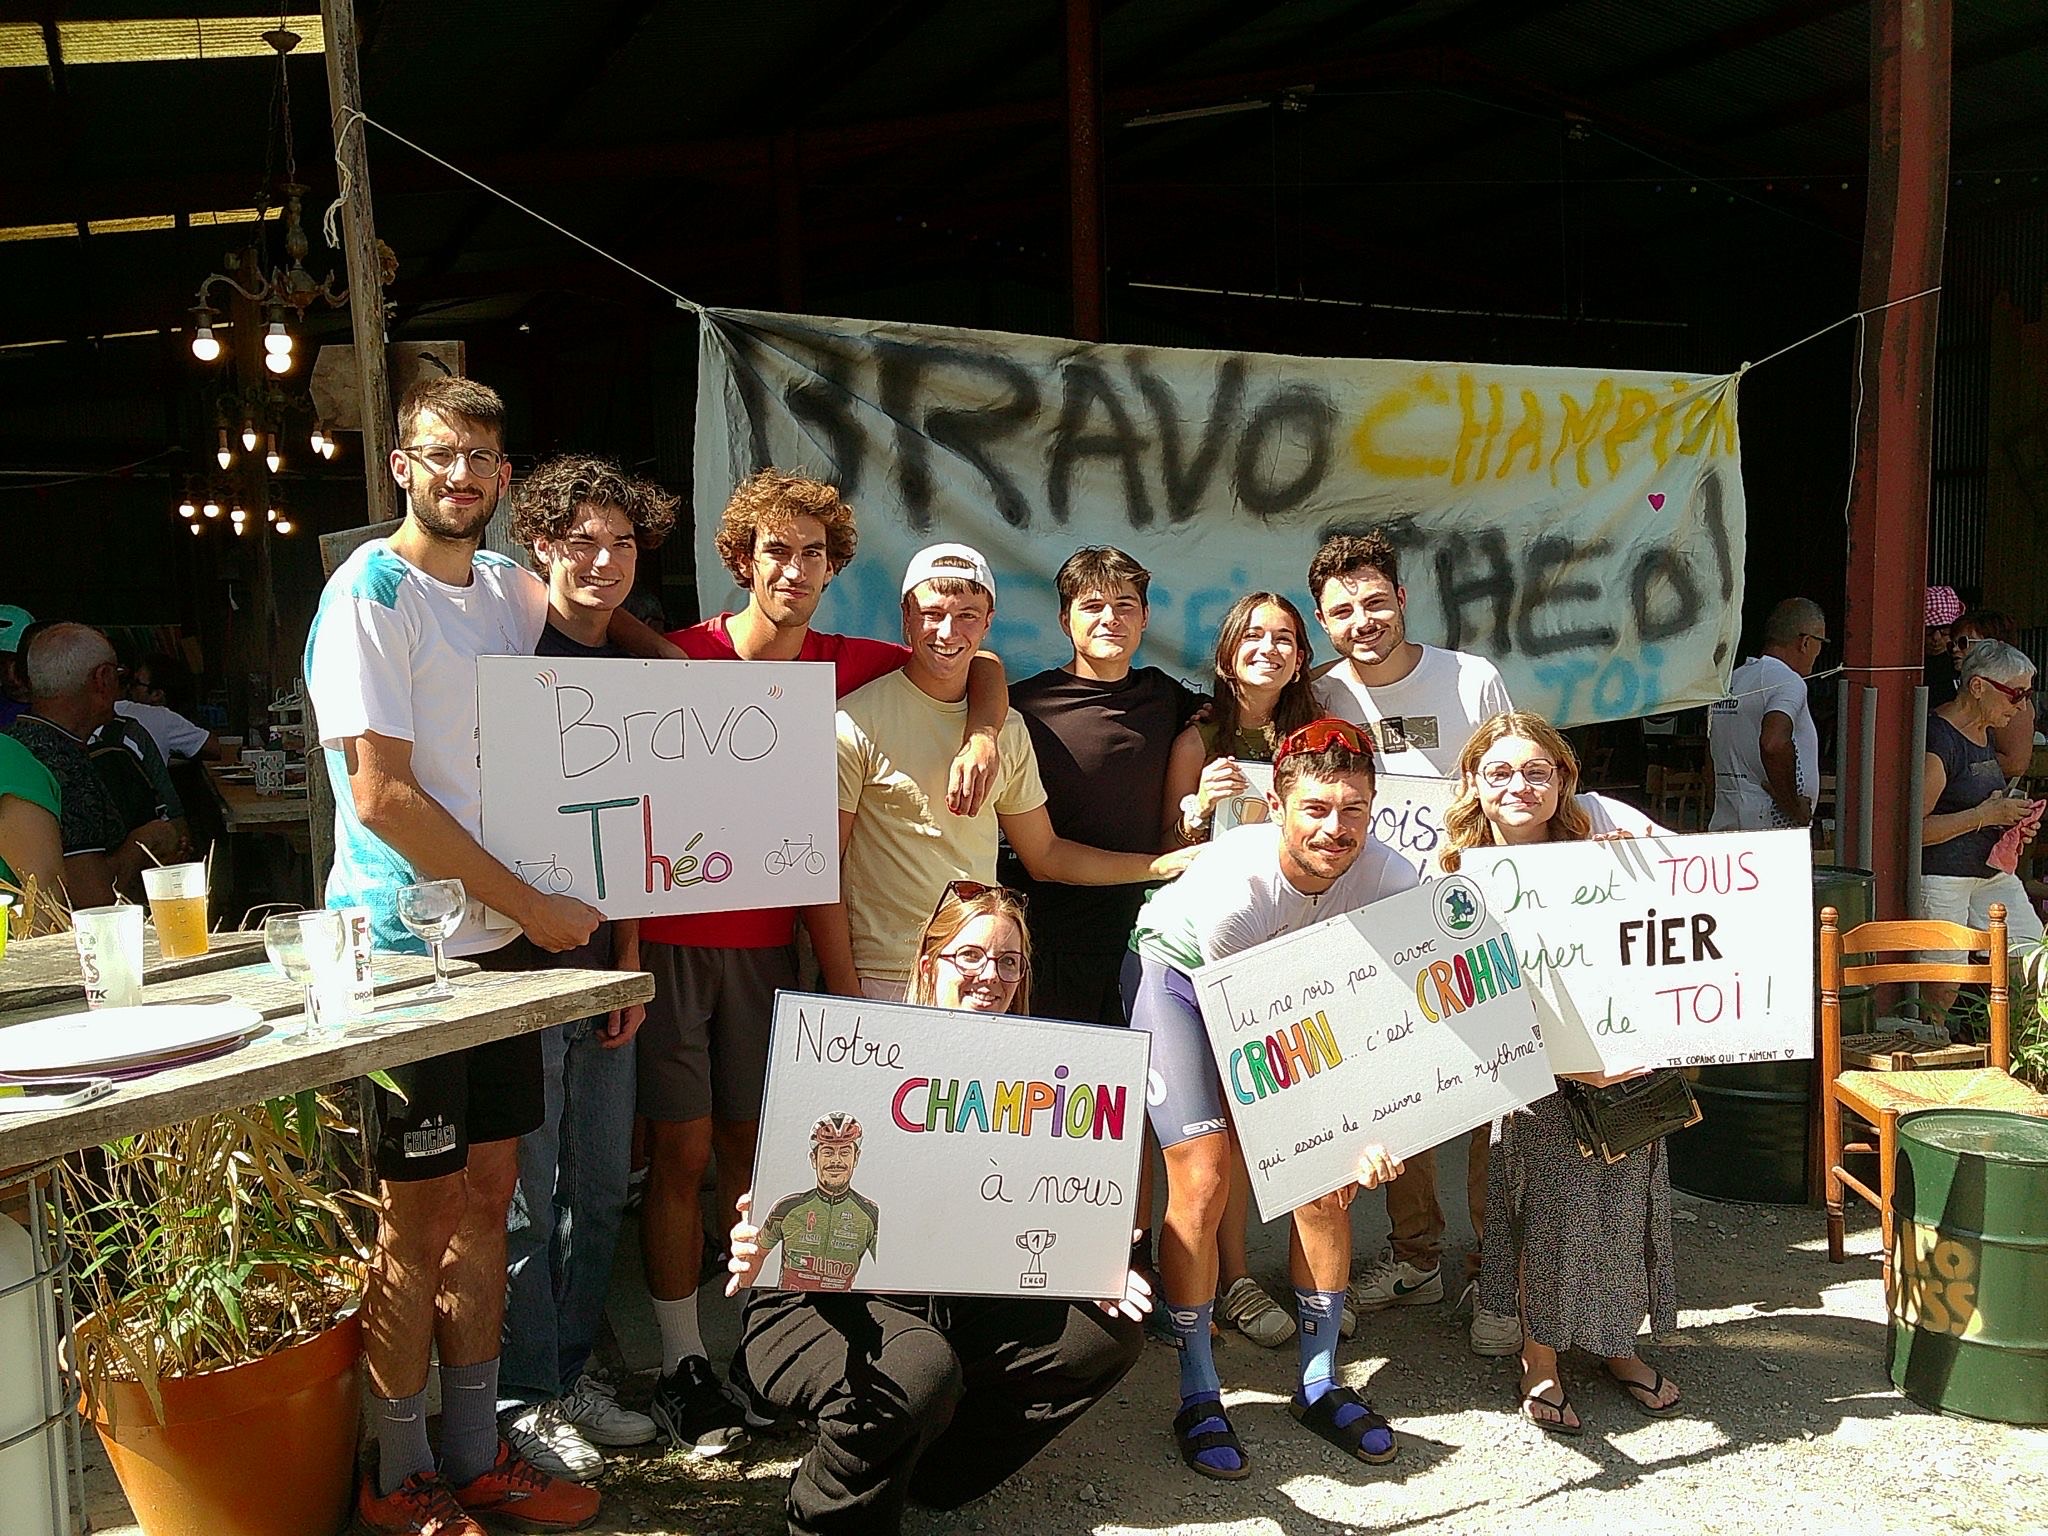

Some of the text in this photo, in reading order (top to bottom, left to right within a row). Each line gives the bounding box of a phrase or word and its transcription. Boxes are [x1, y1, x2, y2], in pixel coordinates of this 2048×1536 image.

[555, 685, 778, 778] Bravo
[557, 794, 733, 900] Théo
[1370, 799, 1438, 852] ois
[1571, 869, 1626, 905] est
[1658, 852, 1759, 896] TOUS
[1208, 938, 1437, 1032] Tu ne vis pas avec
[1366, 1010, 1414, 1051] c'est
[1416, 932, 1521, 1023] CROHN
[795, 1007, 904, 1069] Notre
[1597, 997, 1637, 1035] de
[1667, 1057, 1682, 1066] TES
[403, 1123, 456, 1152] CHICAGO
[1257, 1153, 1286, 1181] qui
[1293, 1127, 1335, 1156] essaie
[1342, 1114, 1360, 1133] de
[1371, 1090, 1422, 1123] suivre
[1436, 1068, 1463, 1094] ton
[980, 1158, 1123, 1206] à nous
